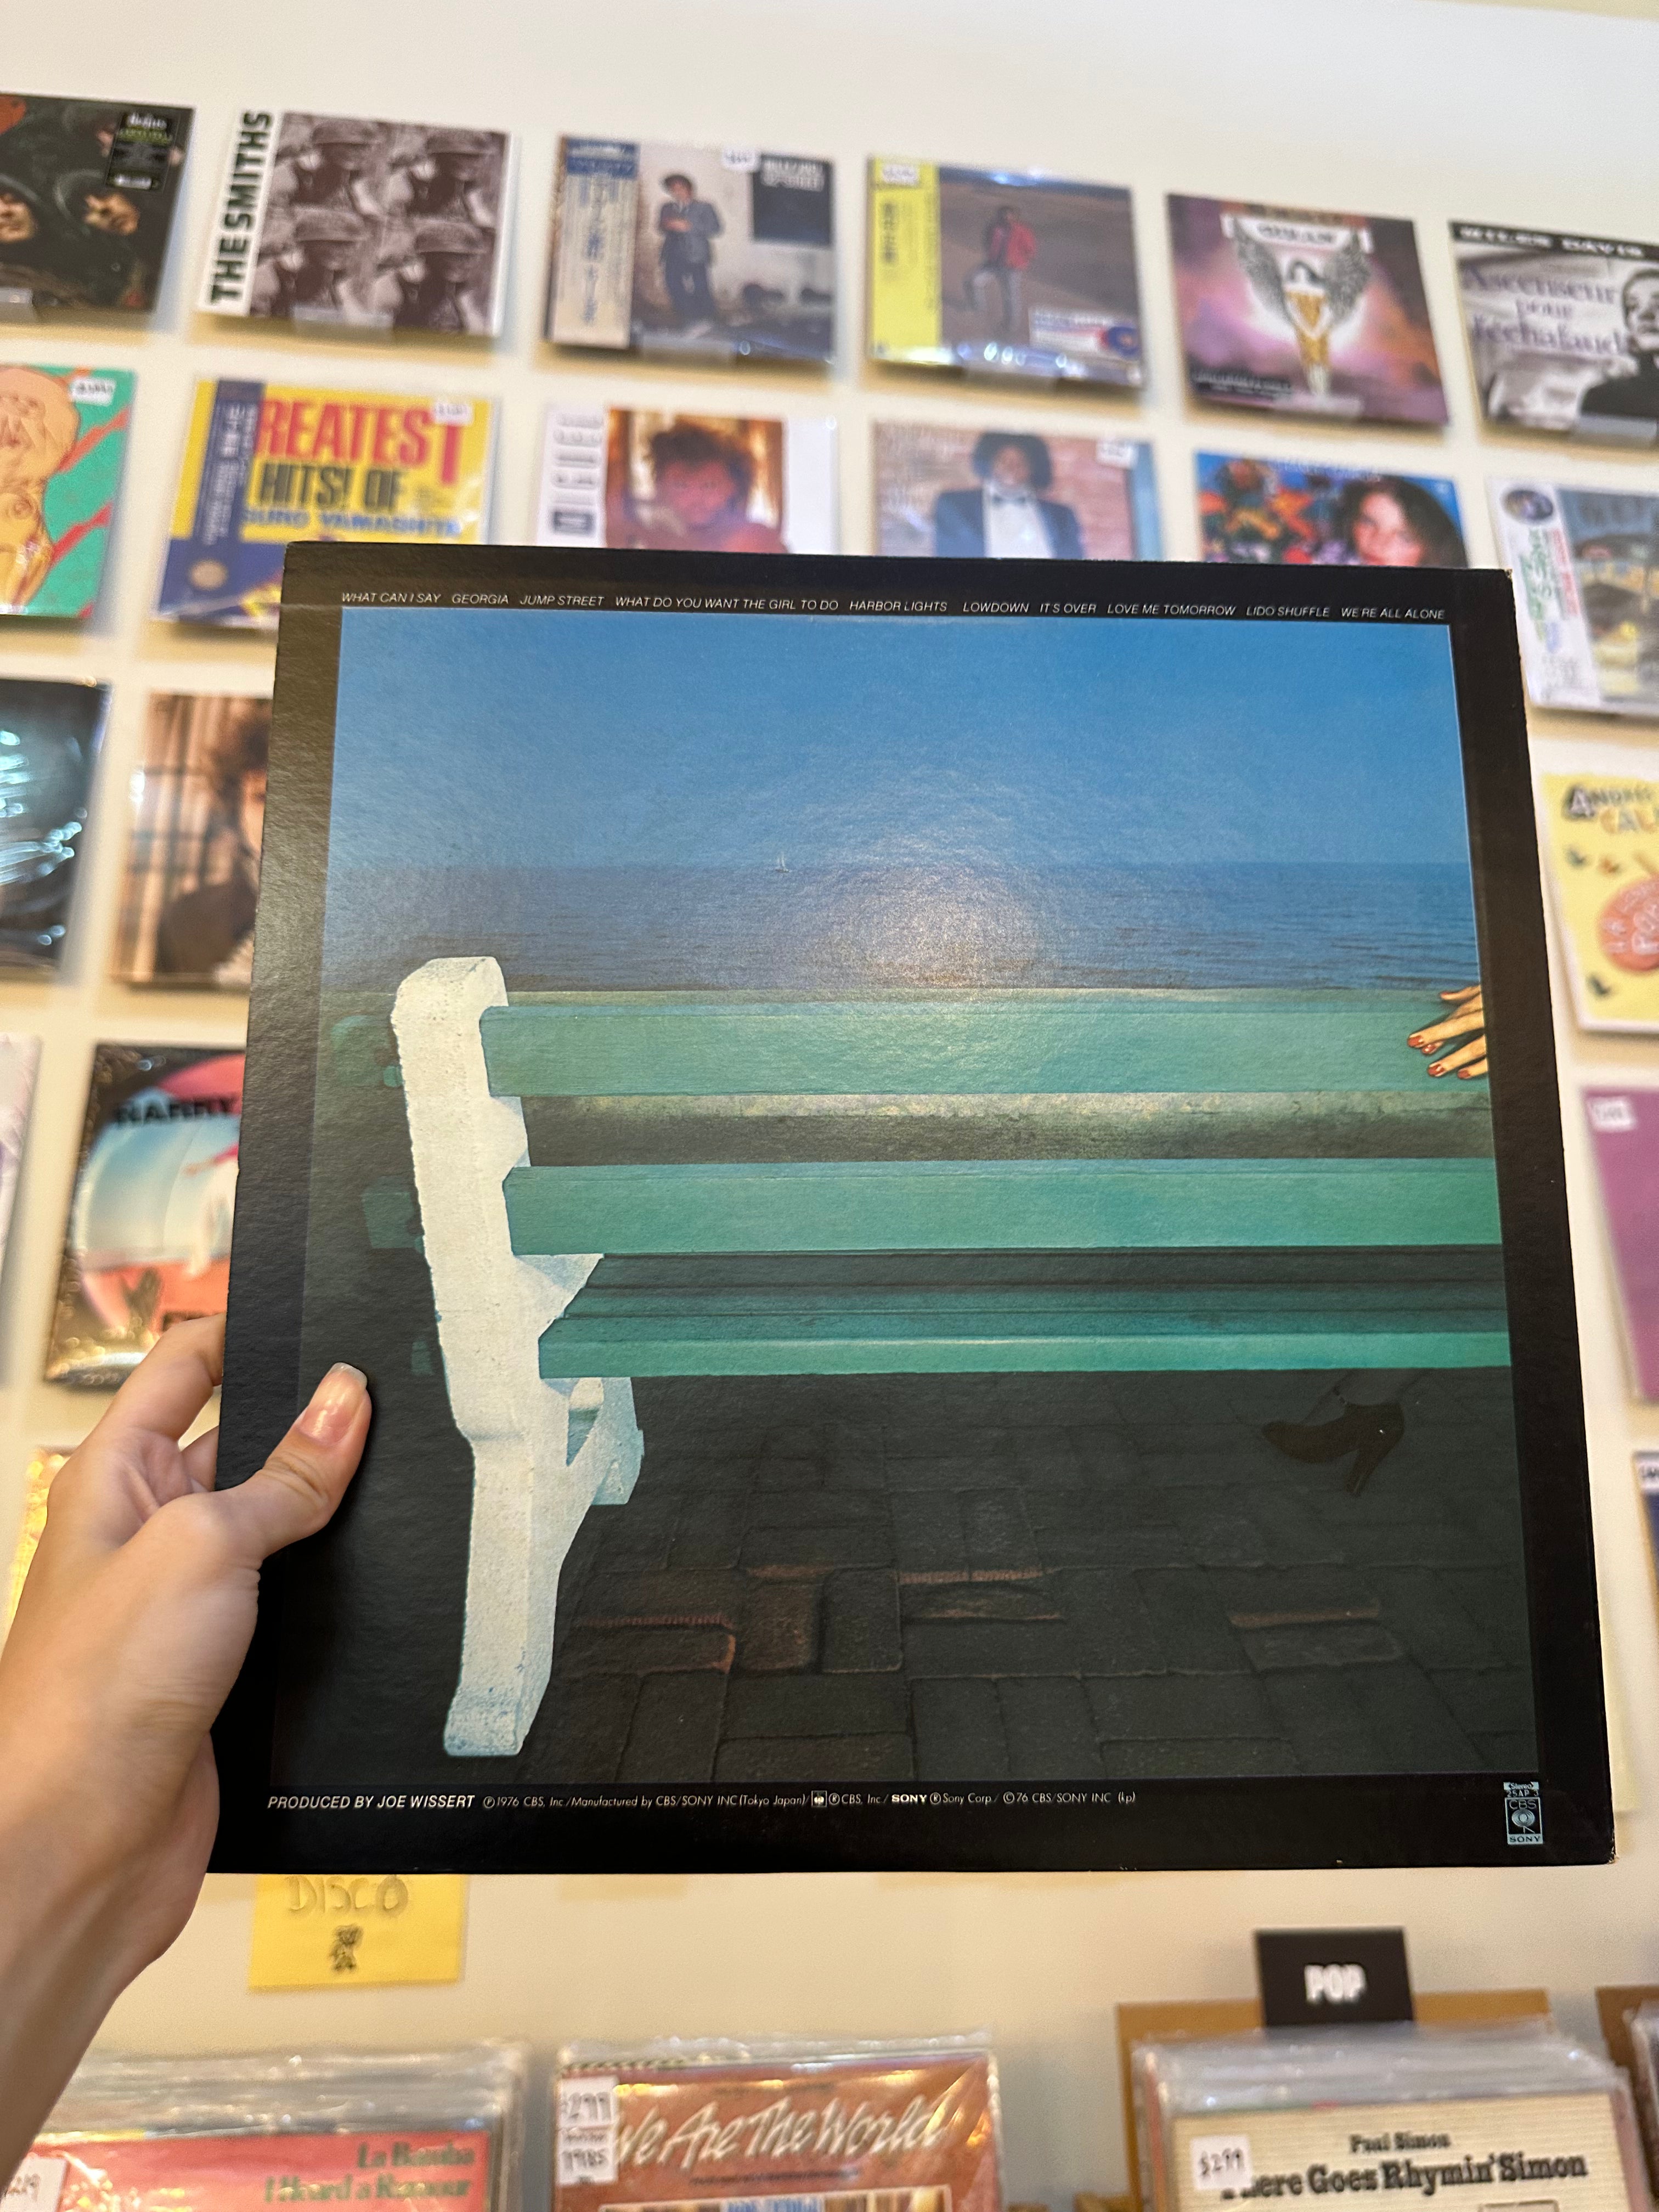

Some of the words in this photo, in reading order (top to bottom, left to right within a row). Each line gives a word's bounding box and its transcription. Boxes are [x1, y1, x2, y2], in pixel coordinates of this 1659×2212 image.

[224, 111, 272, 230] SMITHS
[210, 238, 249, 304] THE
[342, 592, 377, 602] WHAT
[379, 592, 408, 603] CAN
[409, 593, 414, 602] I
[416, 592, 442, 603] SAY
[452, 593, 509, 605] GEORGIA
[520, 595, 555, 605] JUMP
[557, 595, 605, 606] STREET
[616, 596, 651, 607] WHAT
[653, 597, 672, 607] DO
[676, 597, 702, 608] YOU
[705, 598, 740, 608] WANT
[743, 599, 766, 609] THE
[769, 599, 796, 610] GIRL
[801, 599, 817, 610] TO
[820, 600, 839, 611] DO
[849, 600, 901, 611] HARBOR
[904, 601, 947, 612] LIGHTS
[963, 602, 1029, 613] LOWDOWN
[1063, 603, 1097, 613] OVER
[1107, 603, 1139, 614] LOVE
[1142, 603, 1159, 614] ME
[1164, 604, 1236, 616] TOMORROW
[1246, 605, 1275, 616] LIDO
[1277, 606, 1330, 617] SHUFFLE
[1379, 608, 1401, 618] ALL
[1404, 608, 1444, 619] ALONE
[267, 1796, 351, 1809] PRODUCED
[354, 1795, 374, 1808] BY
[377, 1795, 407, 1809] JOE
[410, 1795, 476, 1808] WISSERT
[641, 1795, 653, 1809] by
[656, 1795, 714, 1807] CBS/SONY
[891, 1794, 927, 1803] SONY
[1032, 1792, 1087, 1803] CBS/SONY
[1091, 1792, 1111, 1803] INC
[1509, 1799, 1537, 1810] CBS
[285, 1874, 409, 1915] DISCO
[1304, 1964, 1366, 2002] POP
[657, 2101, 746, 2172] Are
[741, 2096, 818, 2159] The
[814, 2095, 947, 2158] World
[1350, 2133, 1391, 2153] Paul
[1394, 2131, 1453, 2151] Simon
[1306, 2163, 1379, 2194] Goes
[1379, 2152, 1497, 2197] Rhymin'
[1497, 2151, 1589, 2182] Simon
